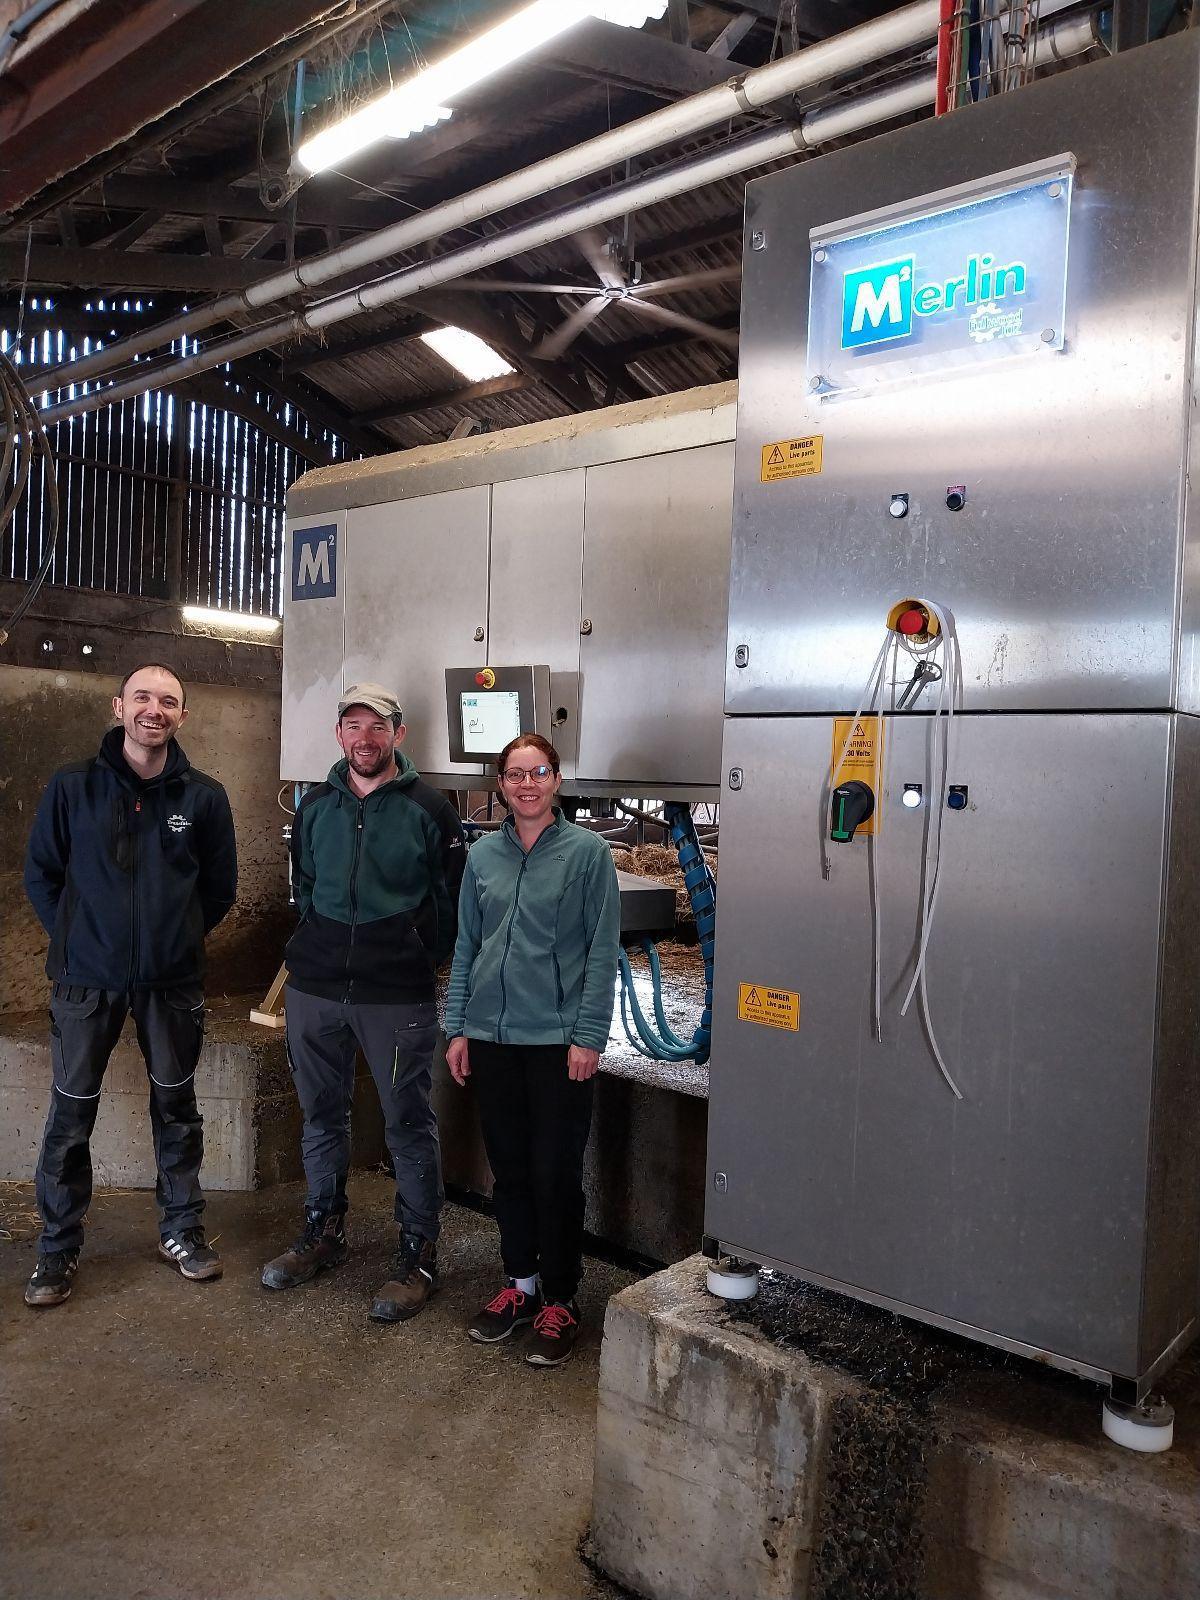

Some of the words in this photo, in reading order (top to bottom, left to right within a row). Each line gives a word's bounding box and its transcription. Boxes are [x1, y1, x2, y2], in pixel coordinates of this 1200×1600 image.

[789, 440, 814, 451] DANGER
[801, 450, 815, 458] parts
[856, 749, 871, 757] Volts
[767, 991, 790, 1002] DANGER
[766, 1000, 777, 1008] Live
[778, 1003, 792, 1011] parts
